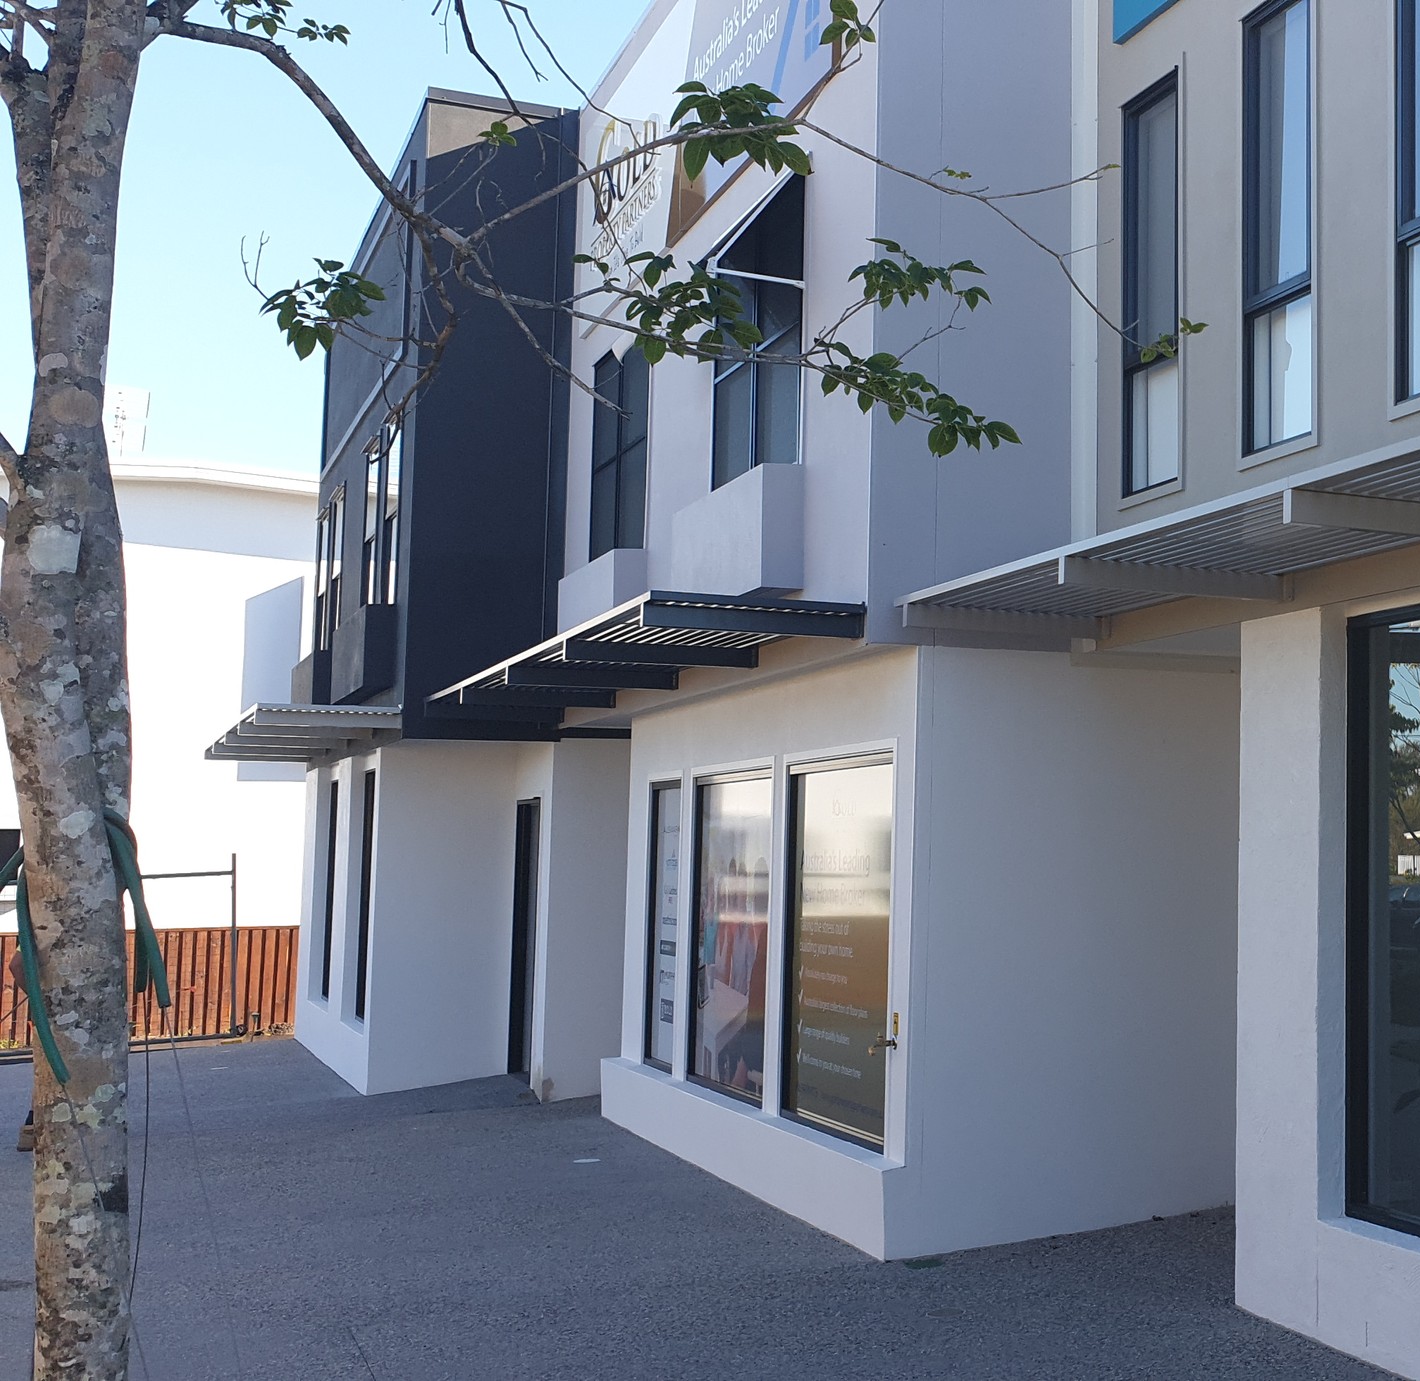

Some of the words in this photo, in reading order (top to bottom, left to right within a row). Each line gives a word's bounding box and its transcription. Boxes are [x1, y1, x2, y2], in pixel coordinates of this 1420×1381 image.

[693, 6, 739, 80] Australia's
[716, 52, 745, 93] Home
[745, 6, 780, 68] Broker
